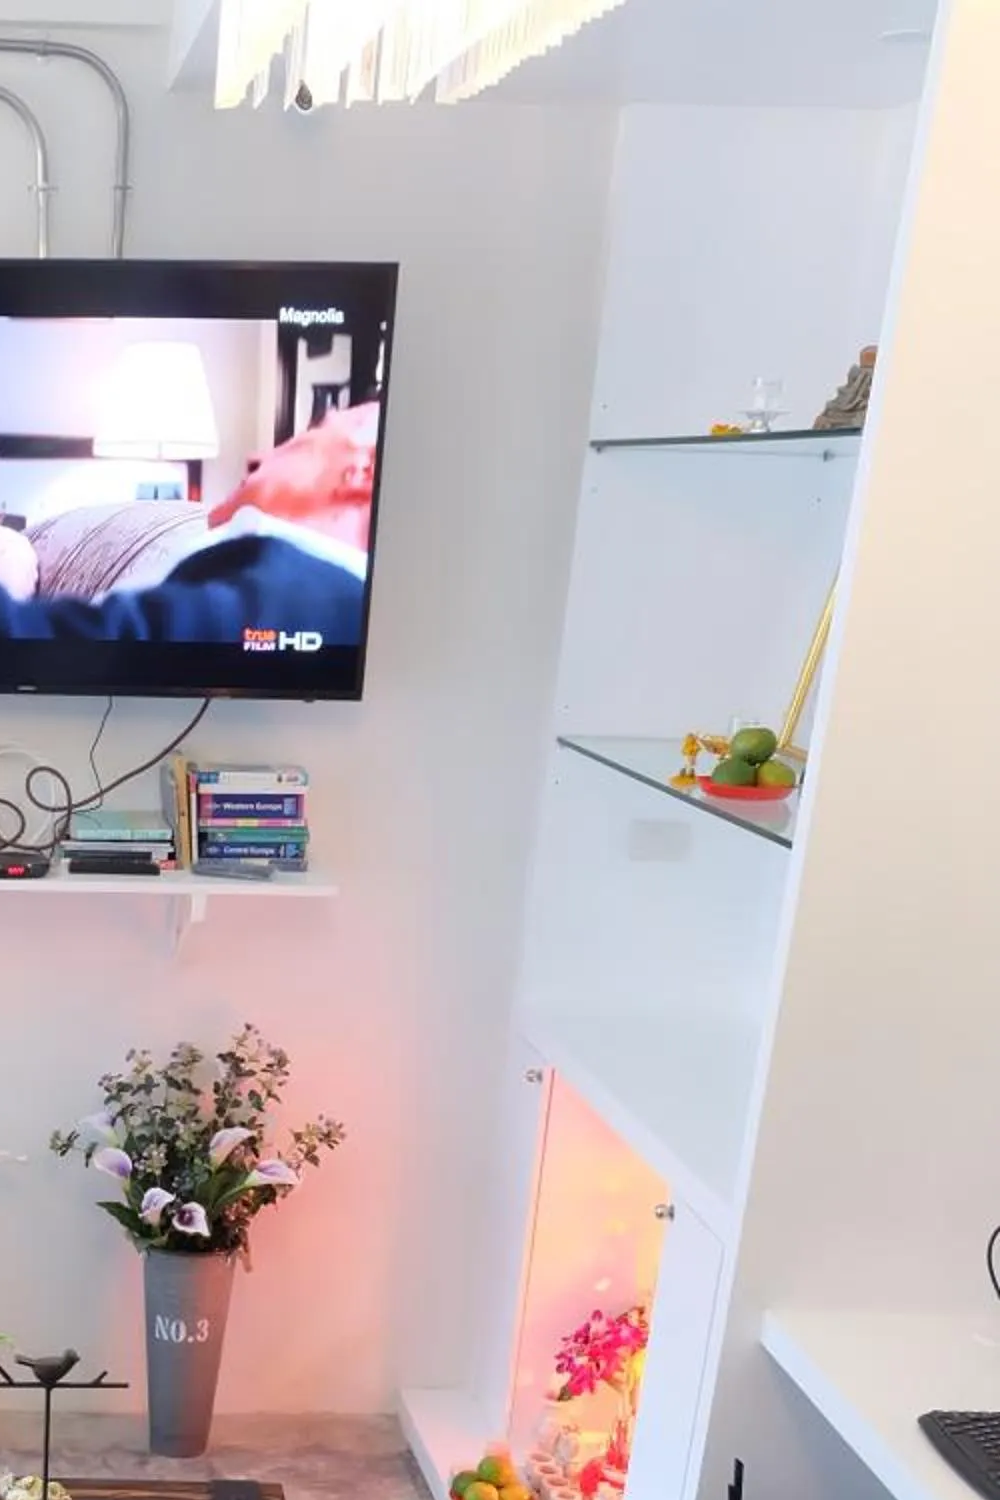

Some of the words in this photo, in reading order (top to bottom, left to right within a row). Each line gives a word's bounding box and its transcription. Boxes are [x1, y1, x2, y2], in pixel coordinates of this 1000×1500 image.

[279, 306, 345, 328] Magnolia
[244, 627, 276, 641] true
[278, 630, 323, 652] HD
[243, 641, 276, 652] FILM
[255, 801, 282, 812] Europe
[154, 1314, 210, 1343] NO.3
